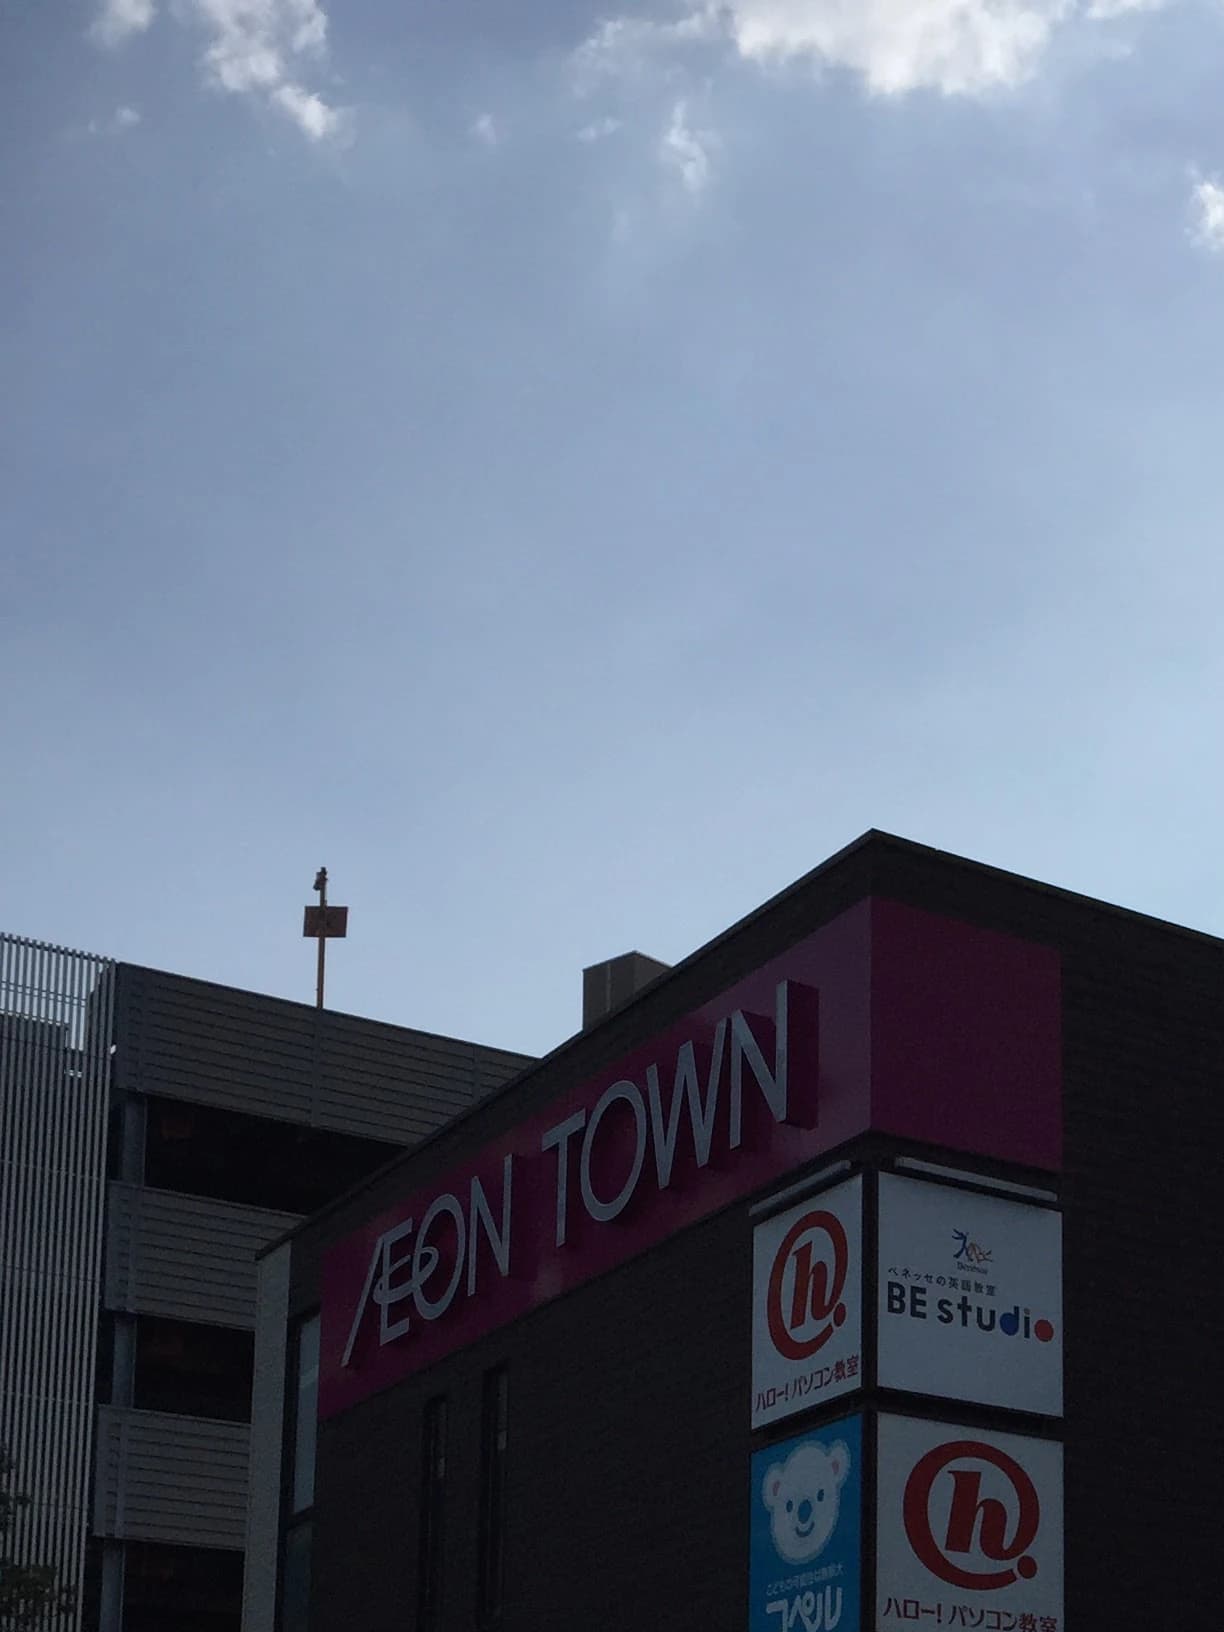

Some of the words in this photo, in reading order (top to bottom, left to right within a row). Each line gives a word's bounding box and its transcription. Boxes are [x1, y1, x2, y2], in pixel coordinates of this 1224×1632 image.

[541, 979, 792, 1248] TOWN
[887, 1281, 927, 1319] BE
[937, 1296, 1054, 1343] studio
